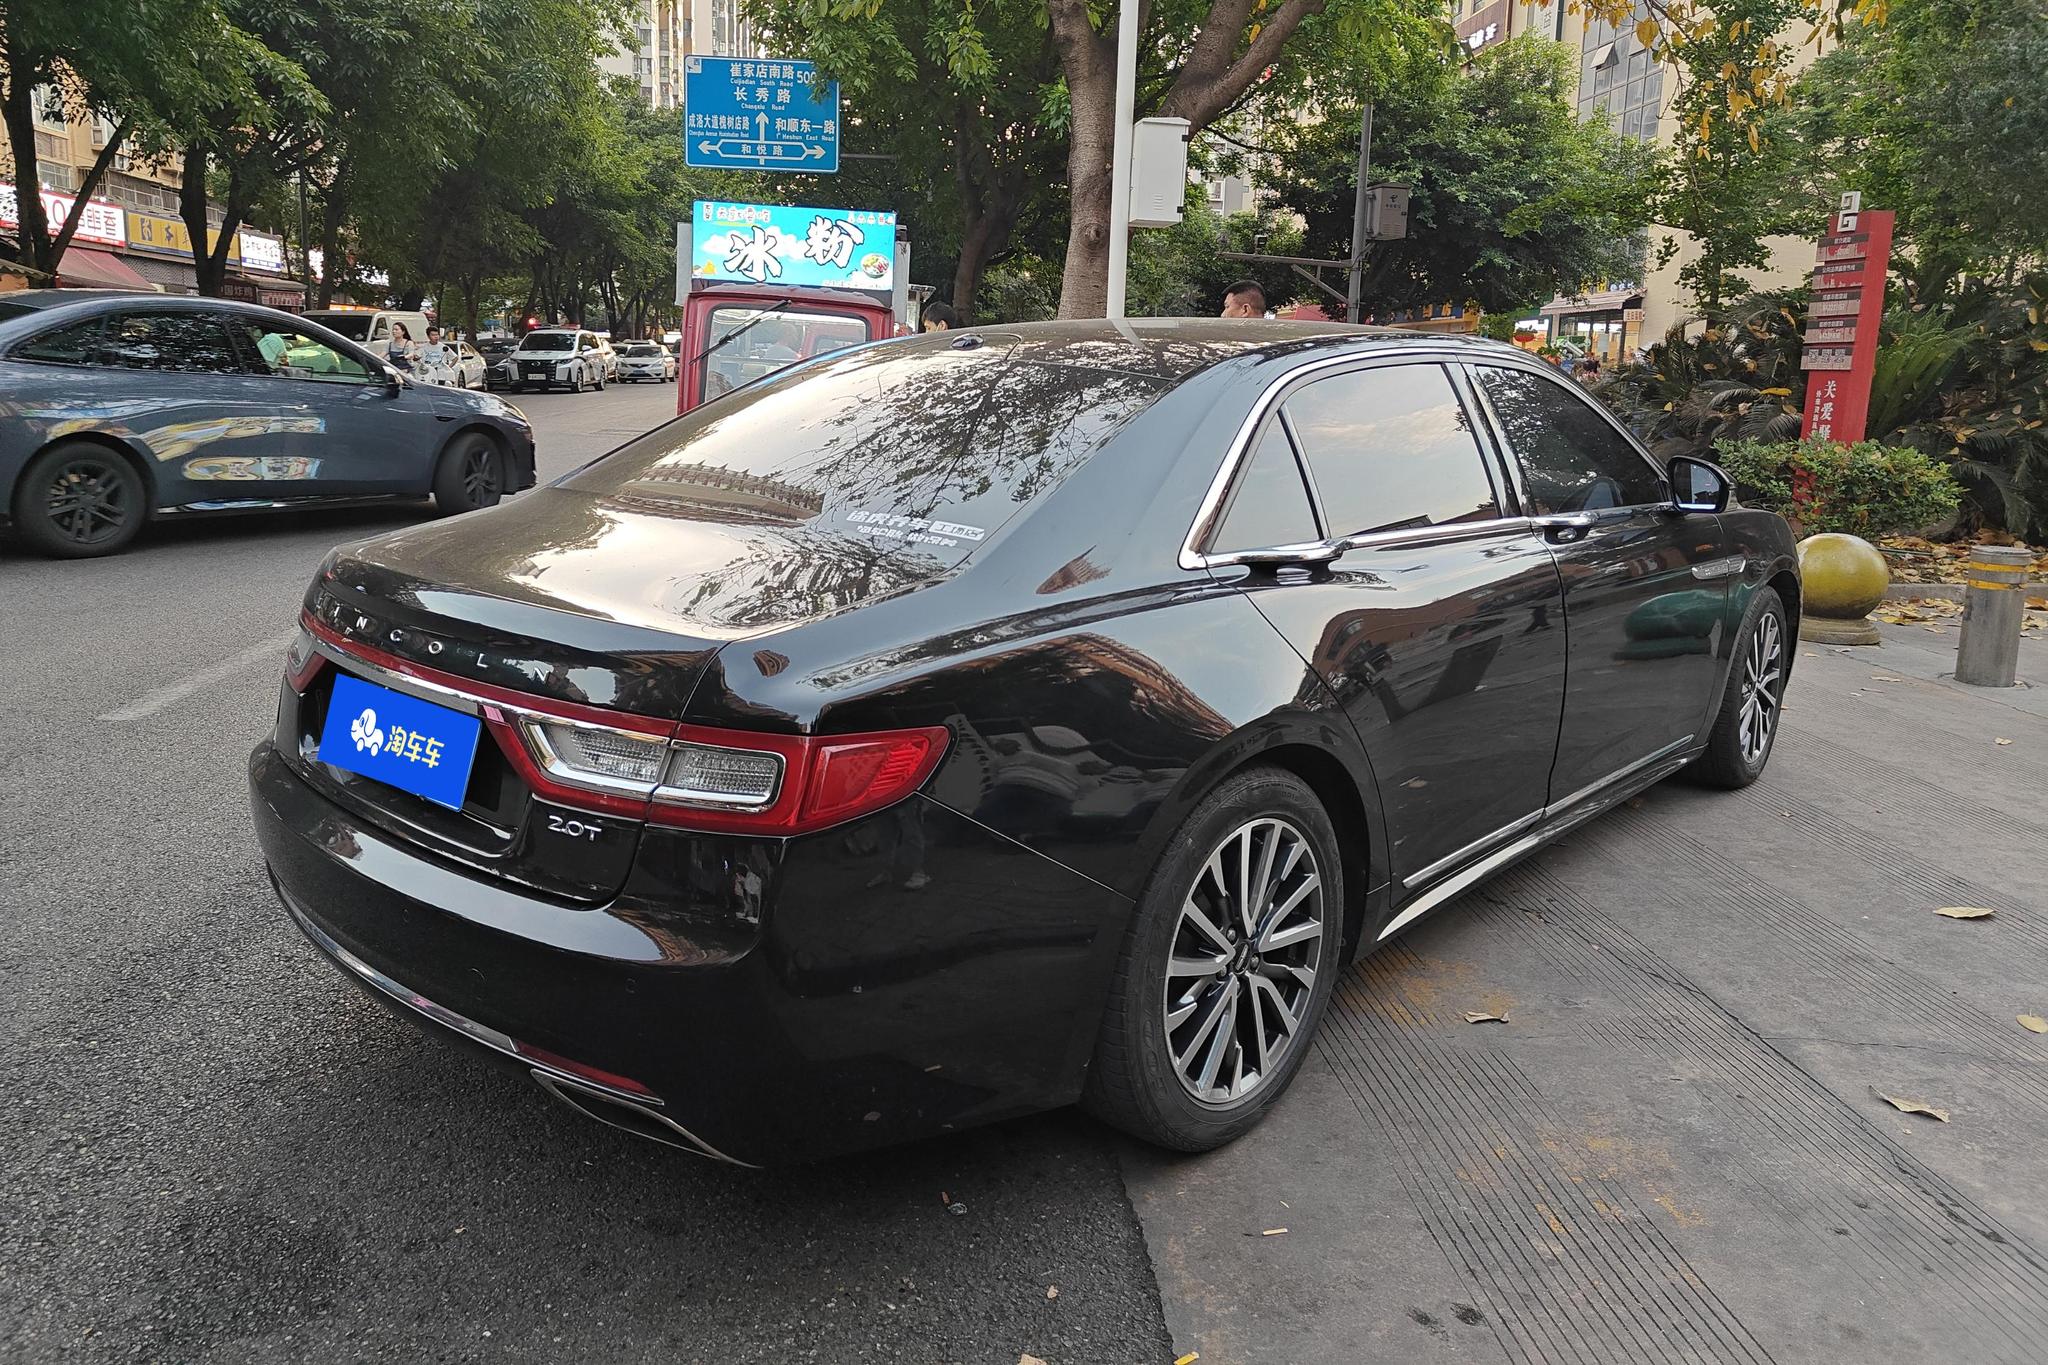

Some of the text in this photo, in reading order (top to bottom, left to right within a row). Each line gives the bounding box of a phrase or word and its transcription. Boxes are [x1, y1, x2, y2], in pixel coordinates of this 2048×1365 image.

[730, 63, 794, 79] 崔家店南路
[733, 86, 791, 104] 长秀路
[775, 117, 836, 135] 和顺东一路
[741, 143, 783, 156] 和悦路
[547, 814, 602, 842] 2.0T
